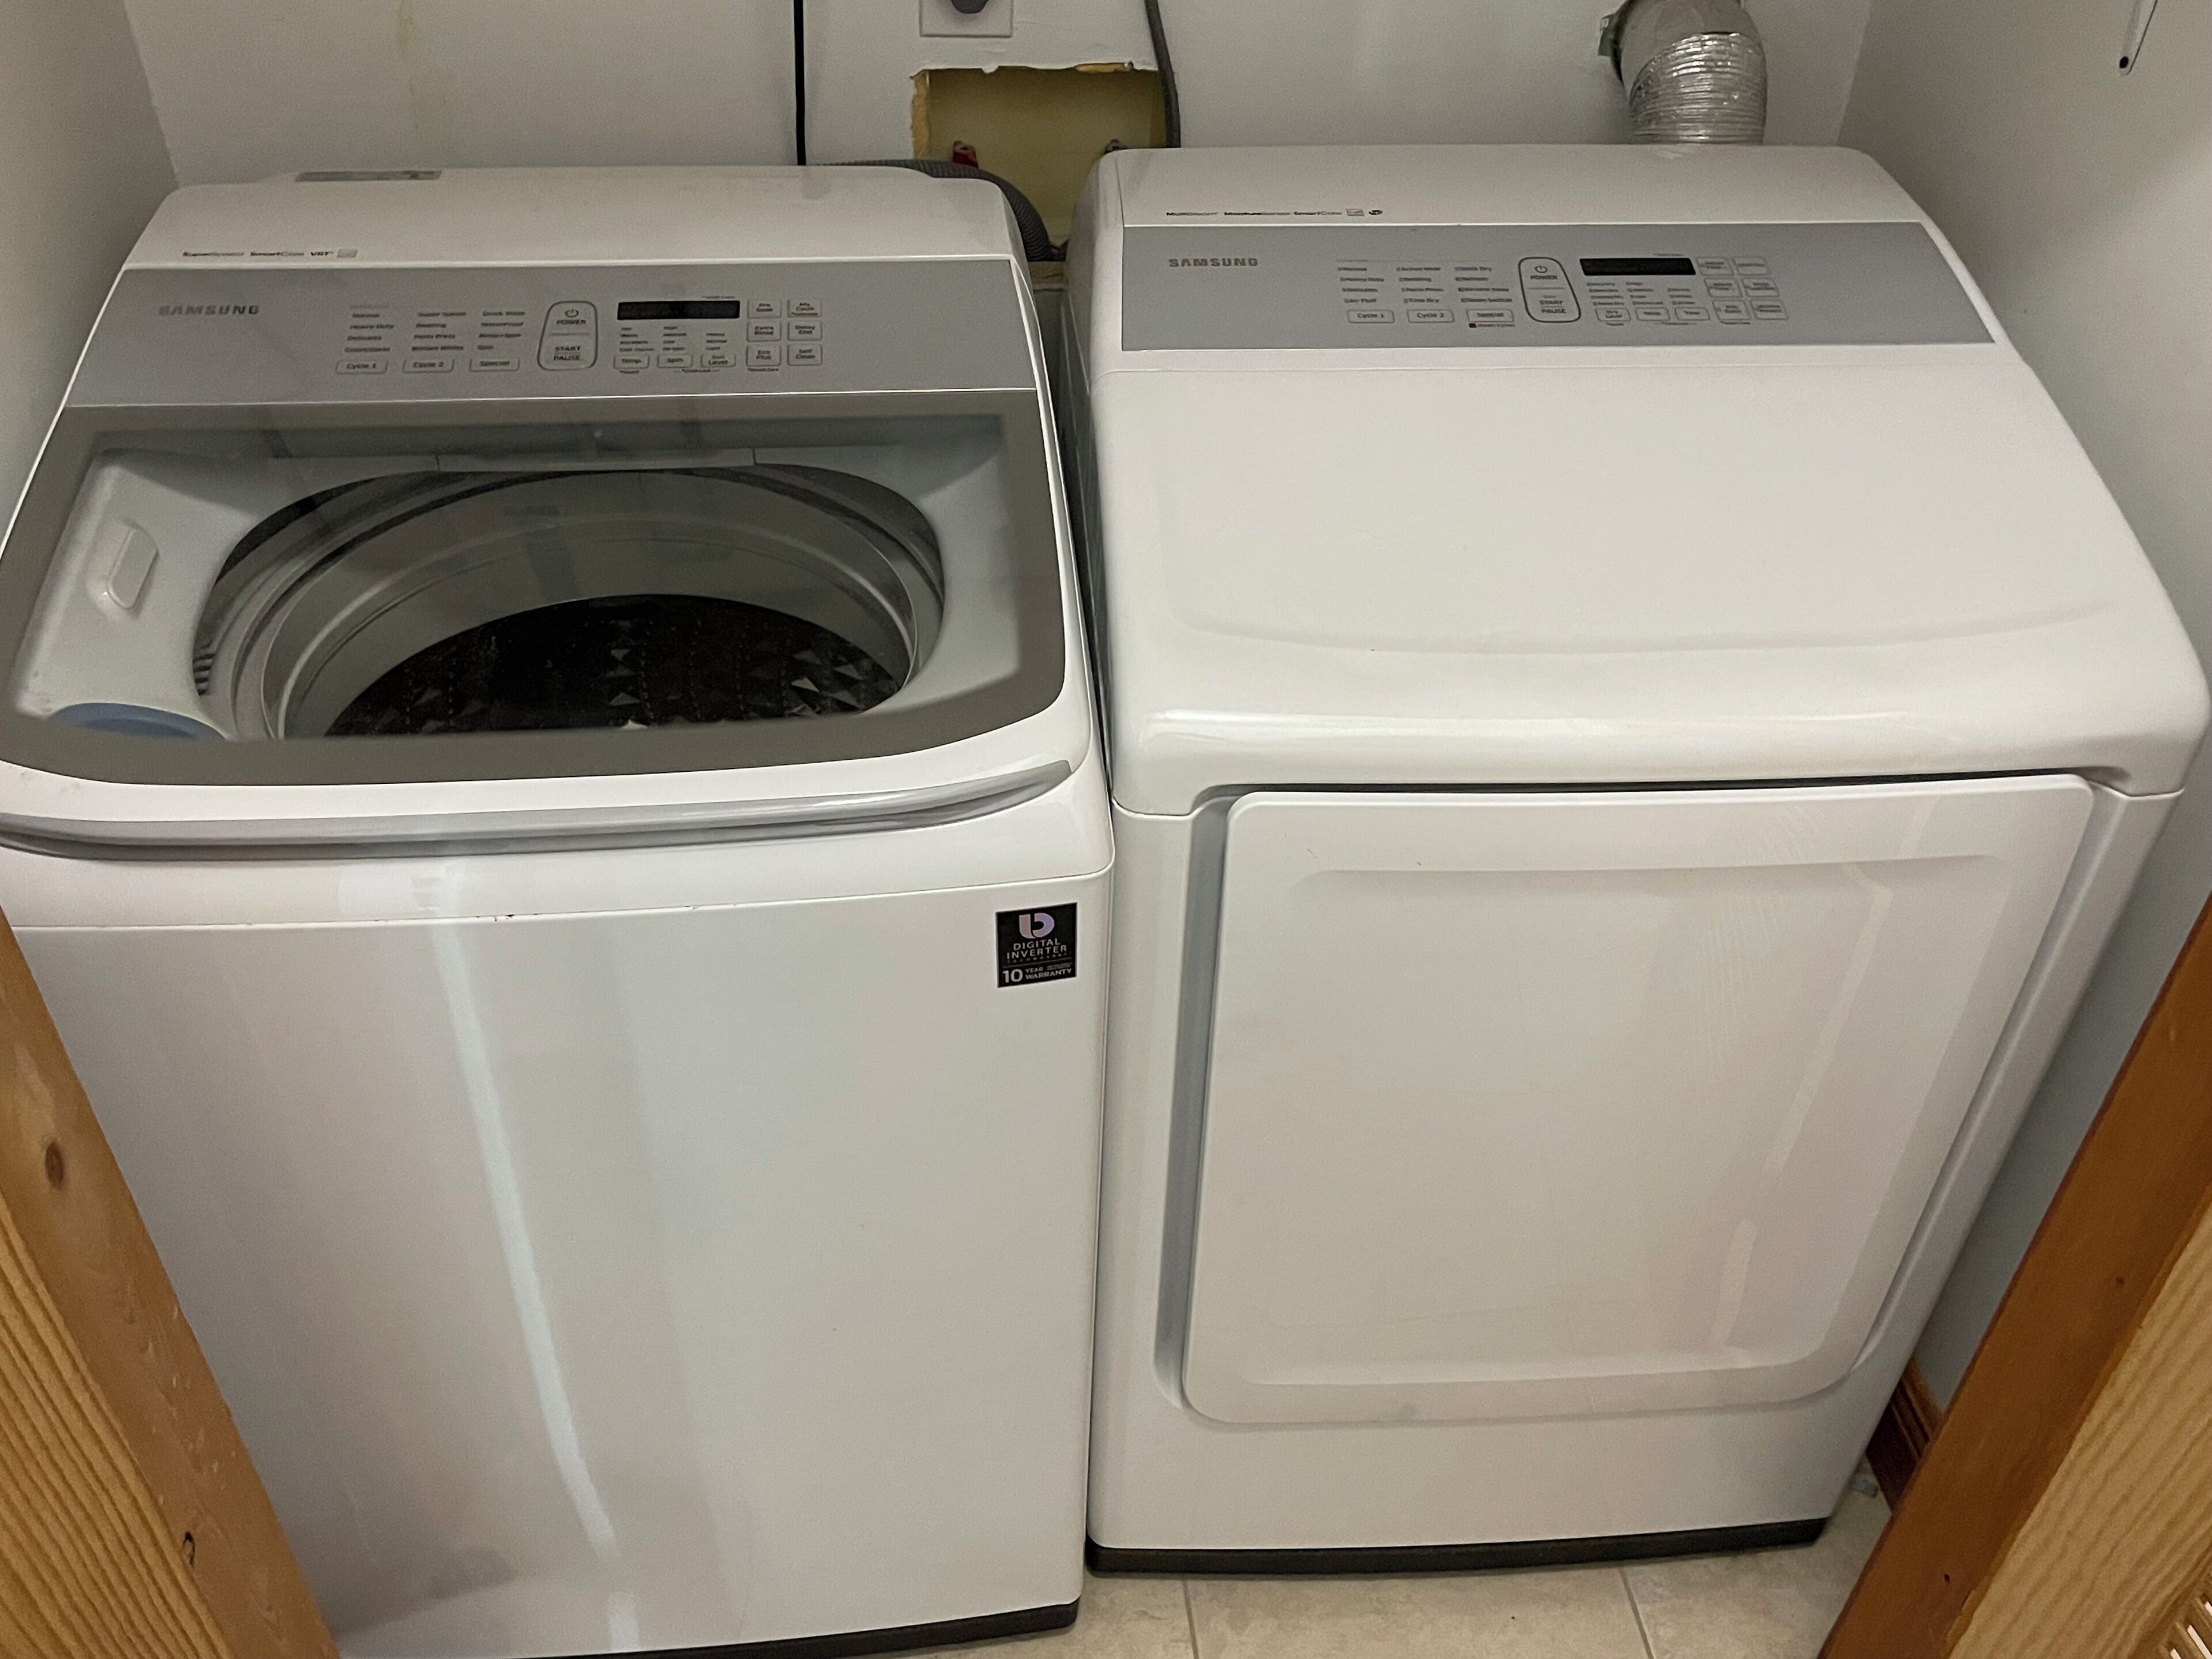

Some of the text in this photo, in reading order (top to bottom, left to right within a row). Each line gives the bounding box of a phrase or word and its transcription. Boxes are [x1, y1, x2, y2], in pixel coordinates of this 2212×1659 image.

[1168, 257, 1259, 268] SAMSUNG
[158, 304, 261, 316] SAMSUNG
[1013, 938, 1061, 951] DIGITAL
[1006, 945, 1067, 960] INVERTER
[1002, 968, 1023, 983] 10
[1025, 968, 1072, 980] WARRANTY
